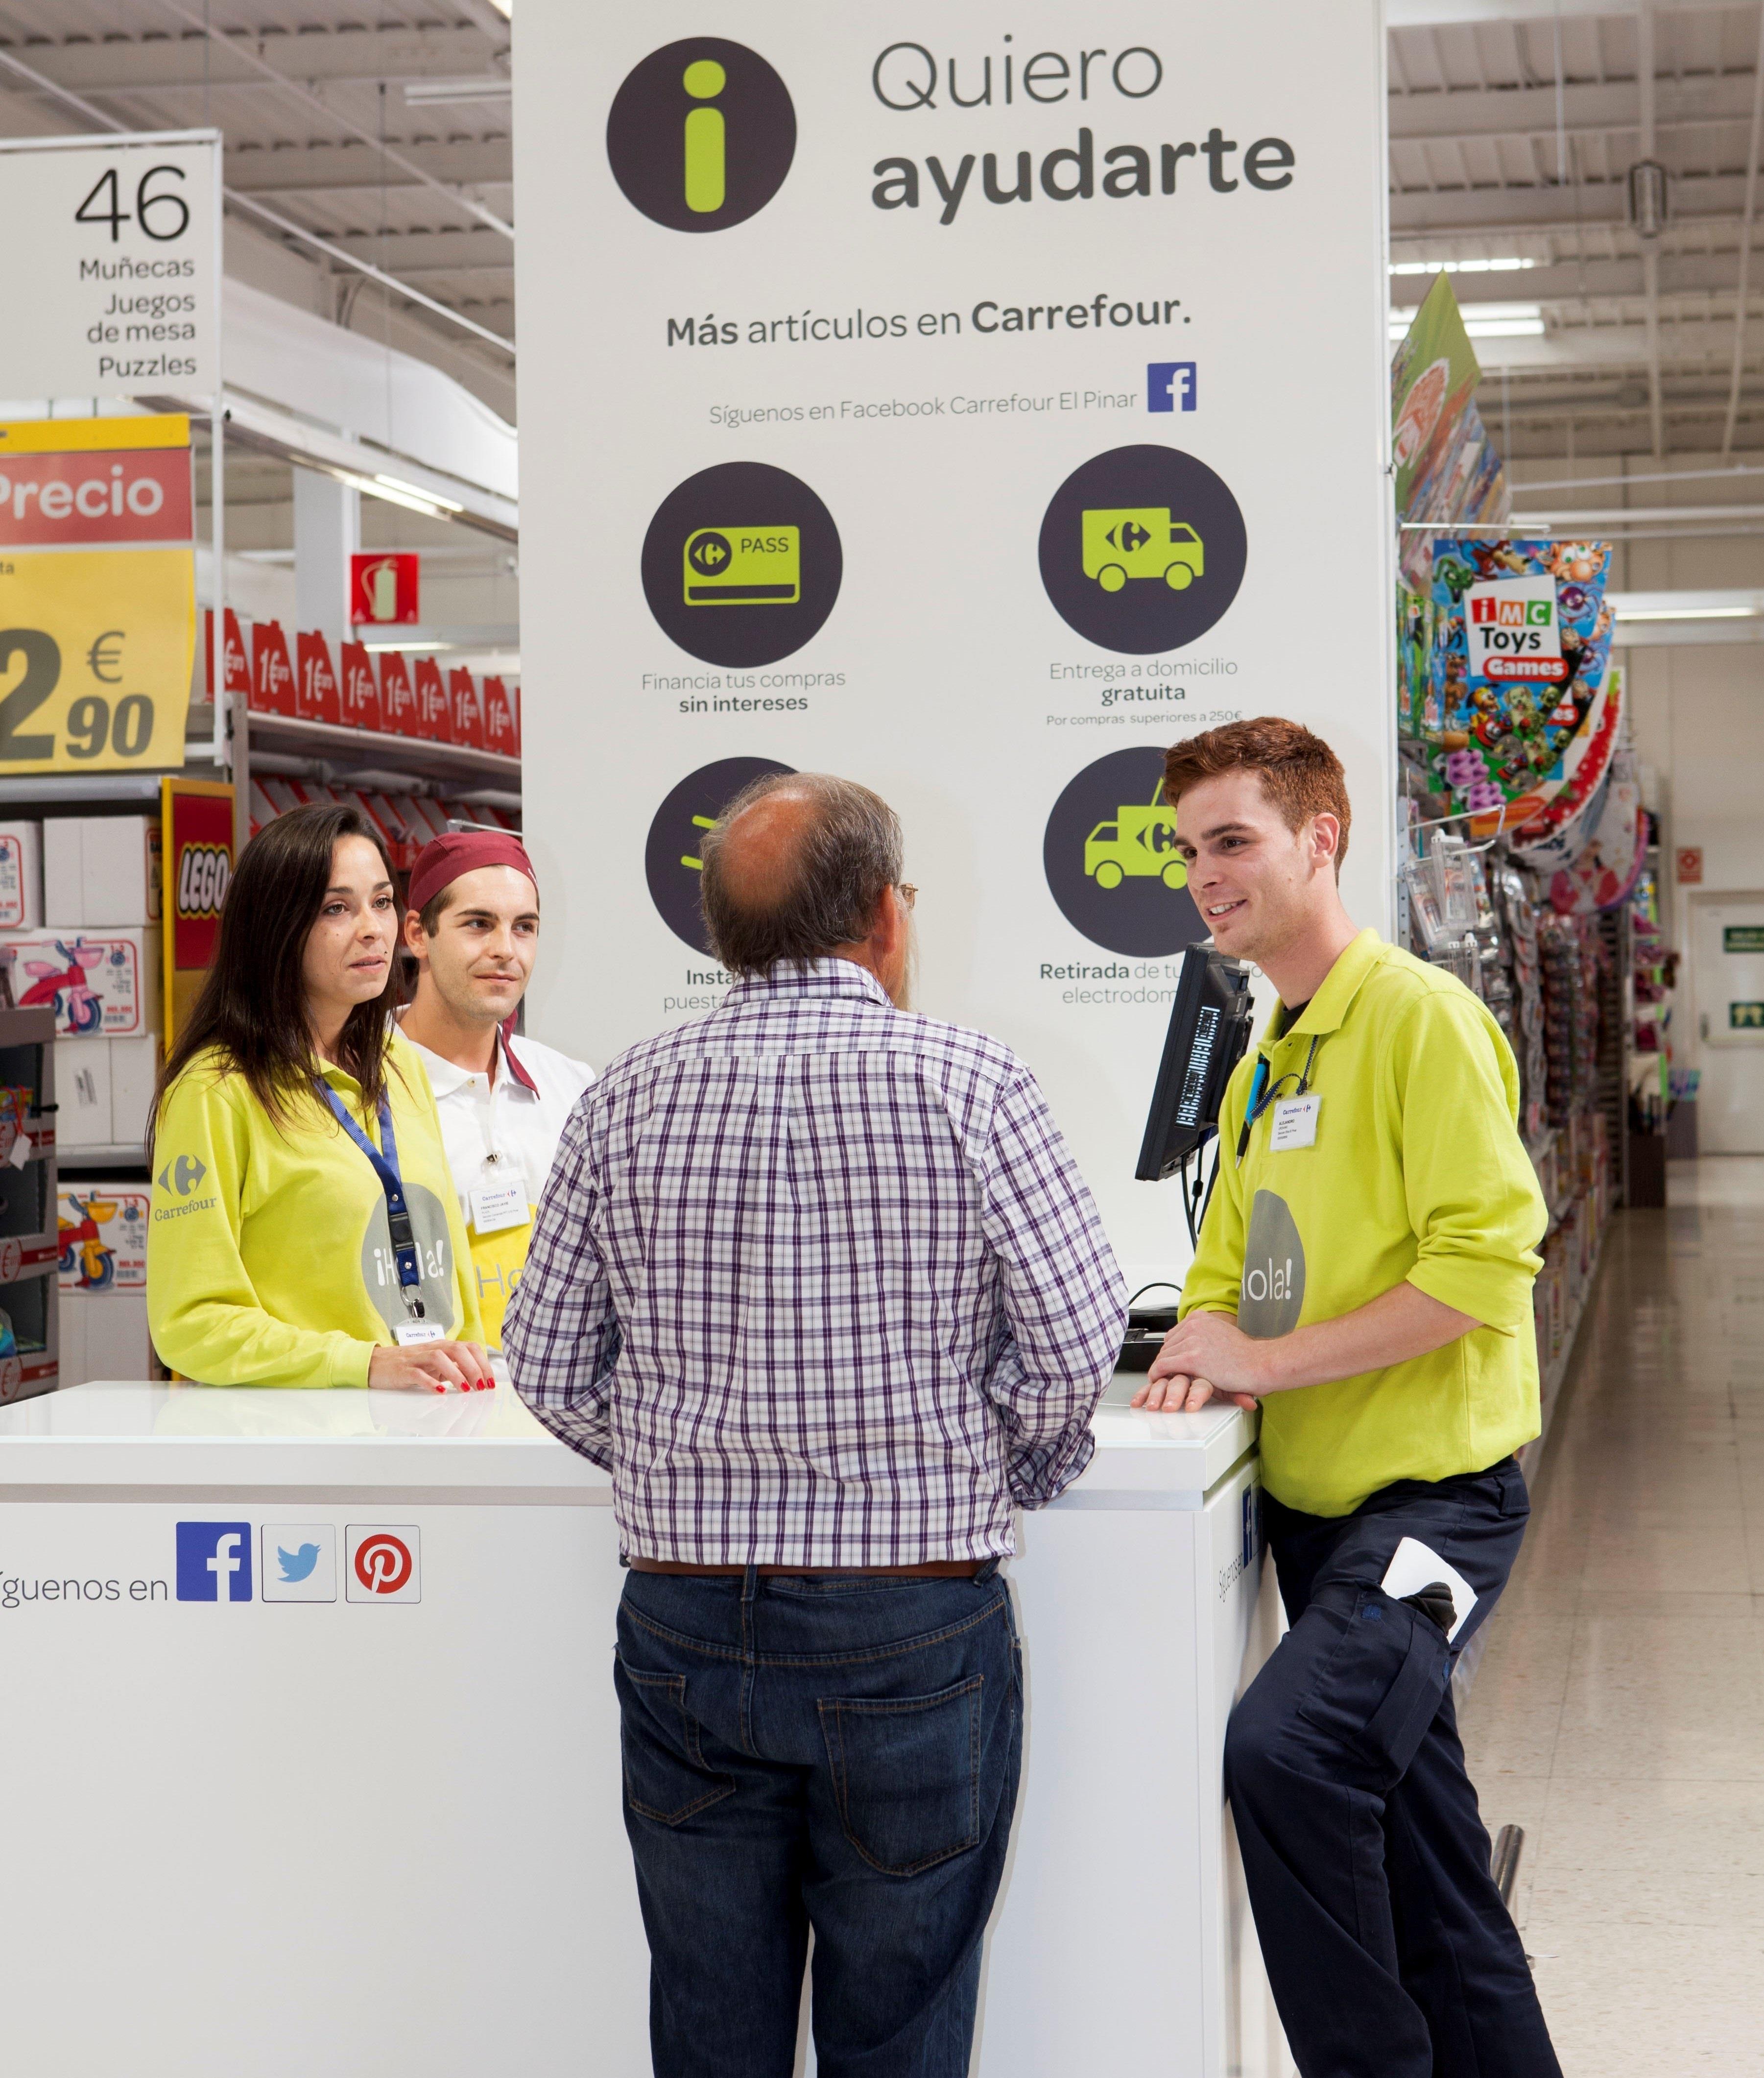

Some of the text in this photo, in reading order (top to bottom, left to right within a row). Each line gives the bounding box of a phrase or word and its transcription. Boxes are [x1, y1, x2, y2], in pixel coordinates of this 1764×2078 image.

[873, 34, 1164, 112] Quiero
[872, 127, 1296, 226] ayudarte
[75, 166, 190, 243] 46
[80, 257, 195, 281] Muñecas
[105, 293, 196, 320] Juegos
[667, 293, 1192, 348] Más artículos en Carrefour.
[87, 322, 196, 344] de mesa
[99, 354, 197, 378] Puzzles
[710, 390, 1138, 429] Síguenos en Facebook Carrefour El Pinar
[740, 537, 789, 554] PASS
[1480, 627, 1541, 653] Toys
[1050, 658, 1239, 683] Entrega a domicilio
[1487, 658, 1564, 677] Games
[642, 672, 847, 691] Financia tus compras
[679, 695, 809, 714] sin intereses
[1101, 683, 1186, 707] gratuita
[66, 694, 155, 760] 90
[1047, 710, 1242, 727] Por compras superiores a 250€
[180, 850, 229, 913] LEGO
[1041, 962, 1130, 980] Retirada
[1134, 962, 1160, 980] de
[1283, 1107, 1303, 1115] Carrefour
[482, 1193, 505, 1201] Carrefour
[154, 1198, 217, 1222] Carrefour
[374, 1239, 444, 1286] ¡Hla!
[0, 1571, 168, 1609] guenos en
